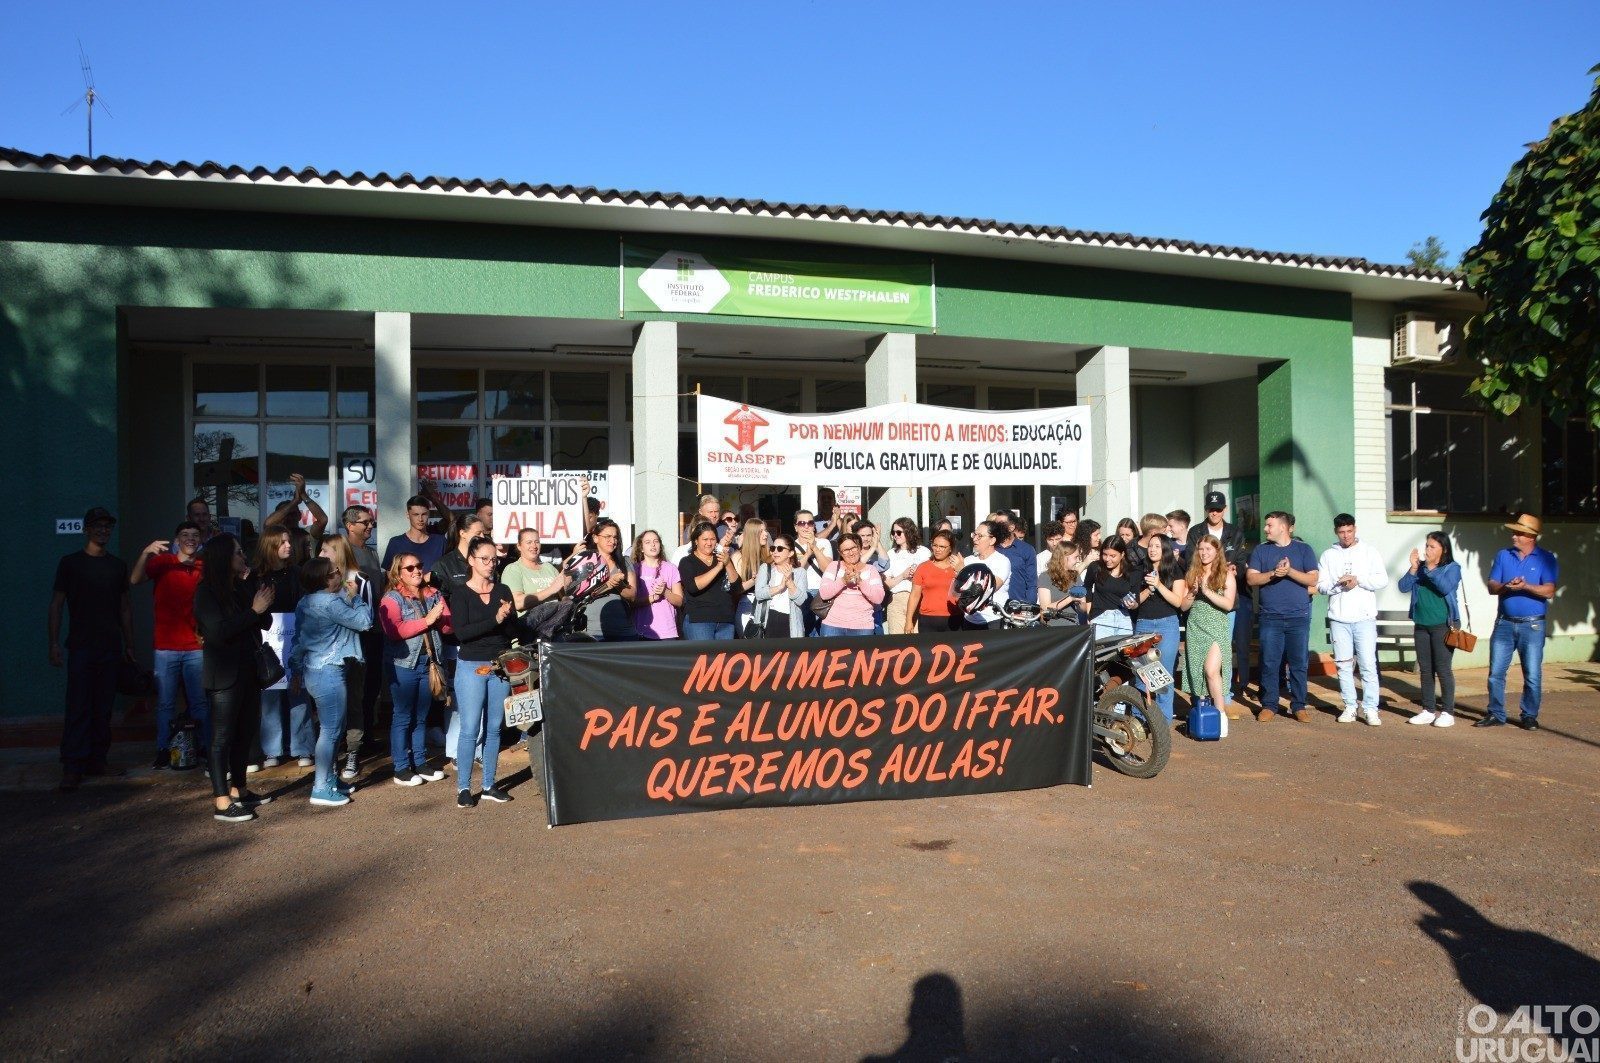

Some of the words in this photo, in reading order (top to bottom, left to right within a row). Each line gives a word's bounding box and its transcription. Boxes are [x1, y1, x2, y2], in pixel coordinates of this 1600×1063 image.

[667, 283, 705, 292] INSTITUTO
[748, 271, 795, 284] CAMPUS
[670, 289, 701, 297] FEDERAL
[748, 283, 821, 299] FREDERICO
[824, 287, 910, 304] WESTPHALEN
[789, 423, 819, 440] POR
[823, 422, 884, 441] NENHUM
[888, 422, 941, 441] DIREITO
[944, 424, 955, 441] A
[958, 424, 1009, 442] MENOS:
[1012, 420, 1082, 445] EDUCAÇÃO
[707, 451, 786, 465] SINASEFE
[814, 447, 876, 471] PÚBLICA
[880, 452, 947, 471] GRATUITA
[951, 453, 959, 470] E
[963, 453, 980, 470] DE
[984, 452, 1062, 470] QUALIDADE.
[497, 479, 578, 506] QUEREMOS
[58, 522, 82, 531] 416
[504, 511, 571, 539] AULA
[682, 646, 922, 695] MOVIMENTO
[926, 643, 984, 685] DE
[509, 709, 538, 725] 9250
[579, 705, 683, 751] PAIS
[688, 702, 721, 746] E
[724, 699, 886, 744] ALUNOS
[890, 692, 947, 736] DO
[952, 687, 1064, 732] IFFAR.
[646, 748, 872, 802] QUEREMOS
[877, 738, 1012, 786] AULAS!
